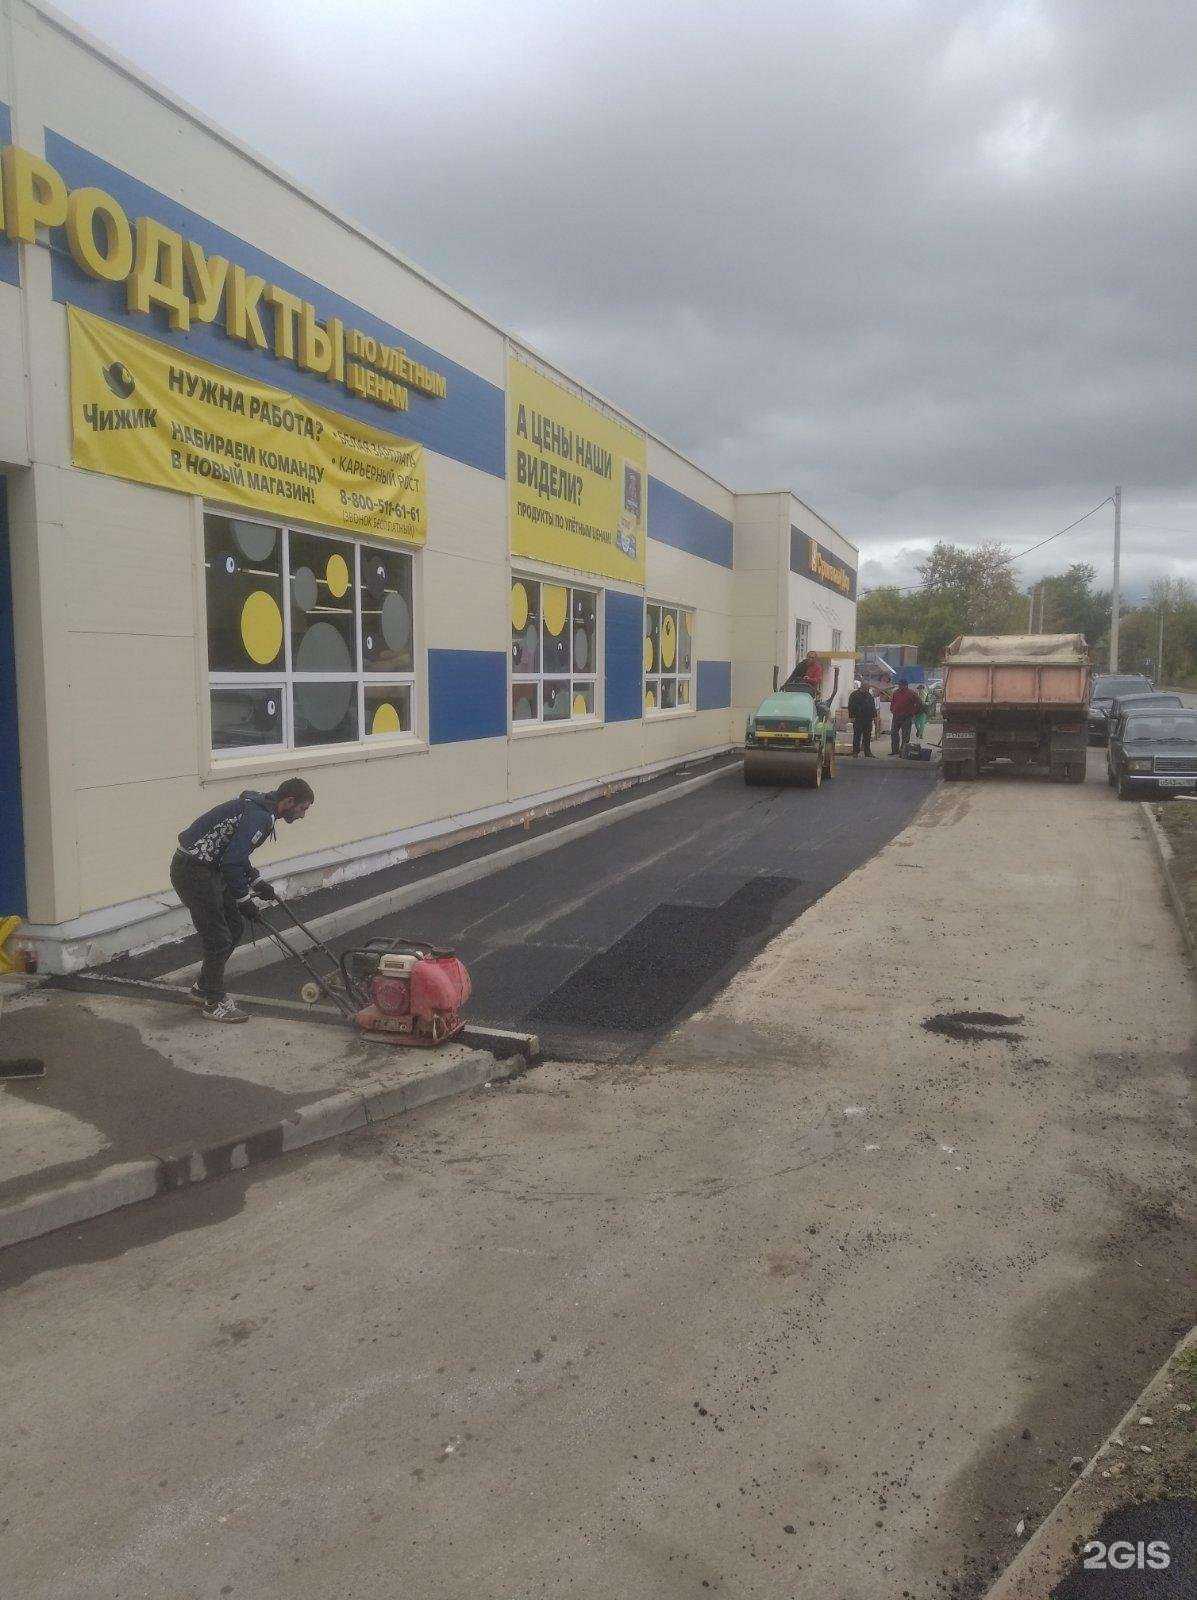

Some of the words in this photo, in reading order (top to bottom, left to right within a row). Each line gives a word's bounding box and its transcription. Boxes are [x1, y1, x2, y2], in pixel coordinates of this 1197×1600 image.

[0, 144, 344, 383] РОДУКТЫ
[168, 365, 245, 416] НУЖНА
[249, 395, 324, 442] РАБОТА?
[347, 363, 408, 411] ЦЕНАМ
[83, 403, 157, 432] Чижик
[516, 402, 528, 440] А
[531, 410, 573, 461] ЦЕНЫ
[575, 434, 613, 480] НАШИ
[171, 421, 255, 464] НАБИРАЕМ
[259, 448, 325, 485] КОМАНДУ
[171, 449, 182, 470] В
[186, 453, 245, 488] НОВЫЙ
[247, 471, 315, 505] МАГАЗИН!
[340, 456, 397, 488] КАРЬЕРНЫЙ
[398, 474, 420, 493] РОСТ
[517, 449, 584, 507] ВИДЕЛИ?
[517, 500, 553, 526] ПРОДУКТЫ
[555, 512, 565, 530] ПО
